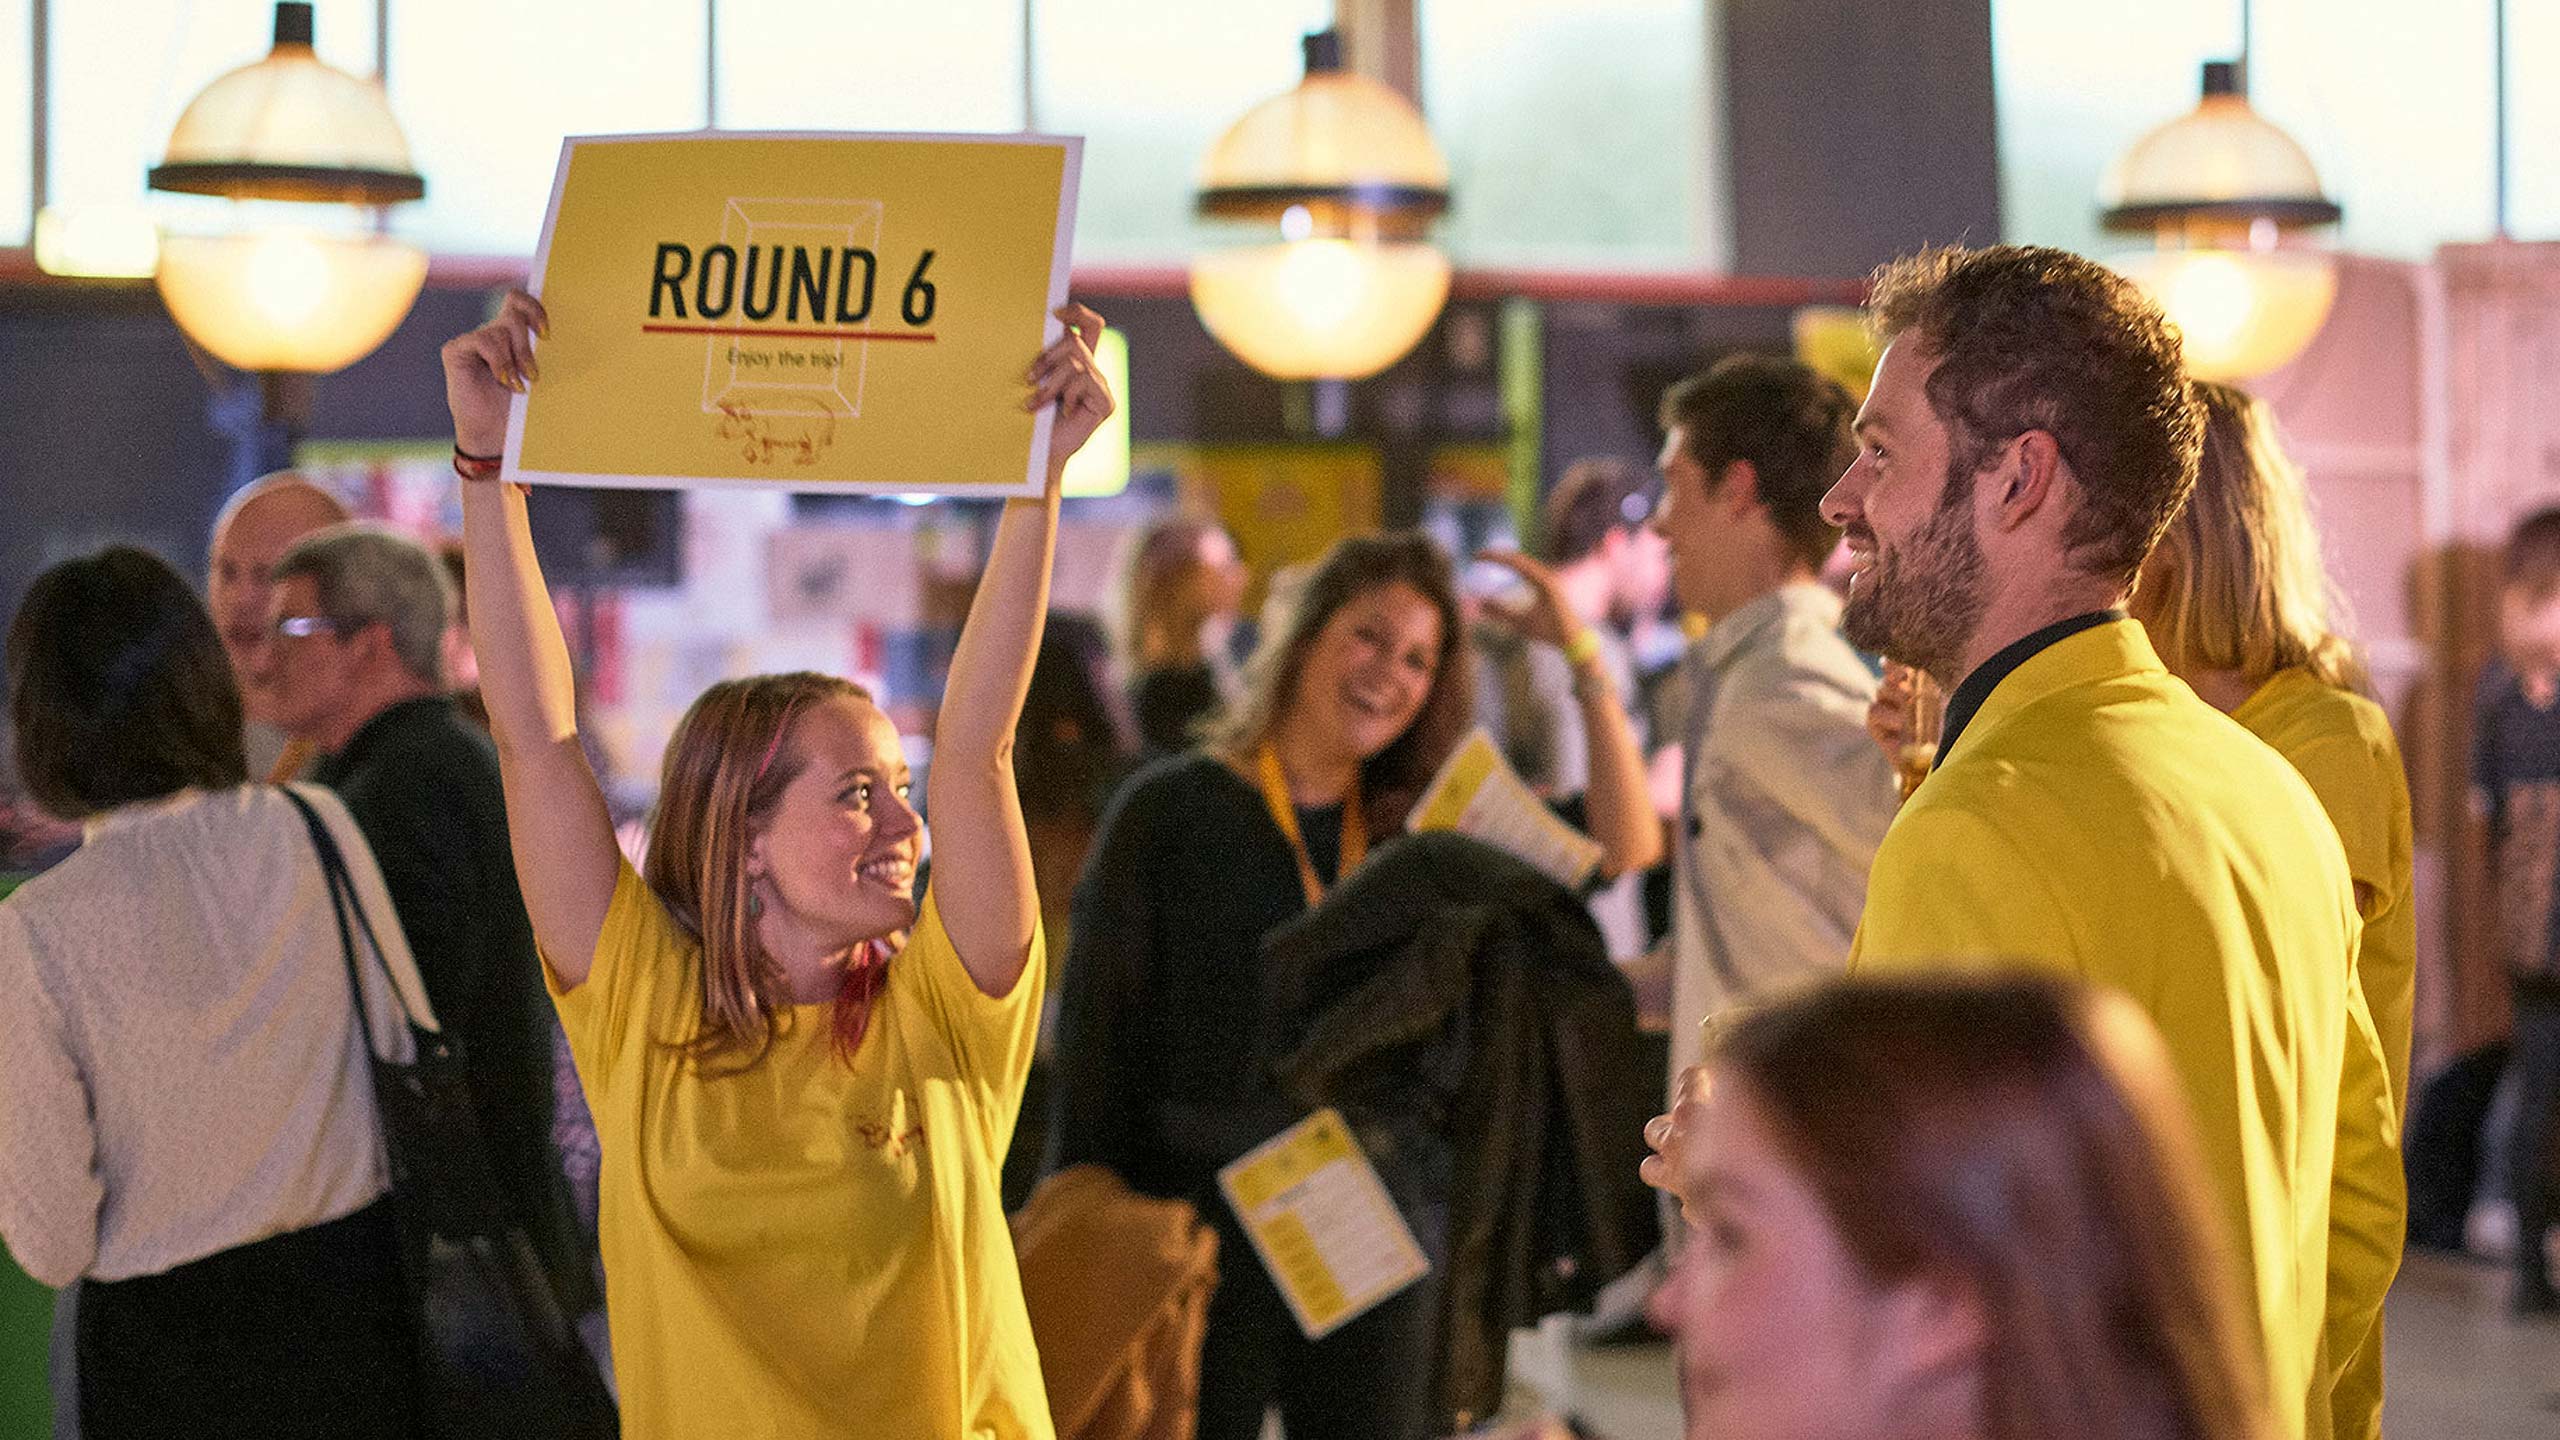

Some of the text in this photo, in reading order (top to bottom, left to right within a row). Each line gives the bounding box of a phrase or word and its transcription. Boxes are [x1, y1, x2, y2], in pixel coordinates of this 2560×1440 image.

[649, 242, 936, 326] ROUND 6
[727, 346, 845, 371] Enjoy the trip!
